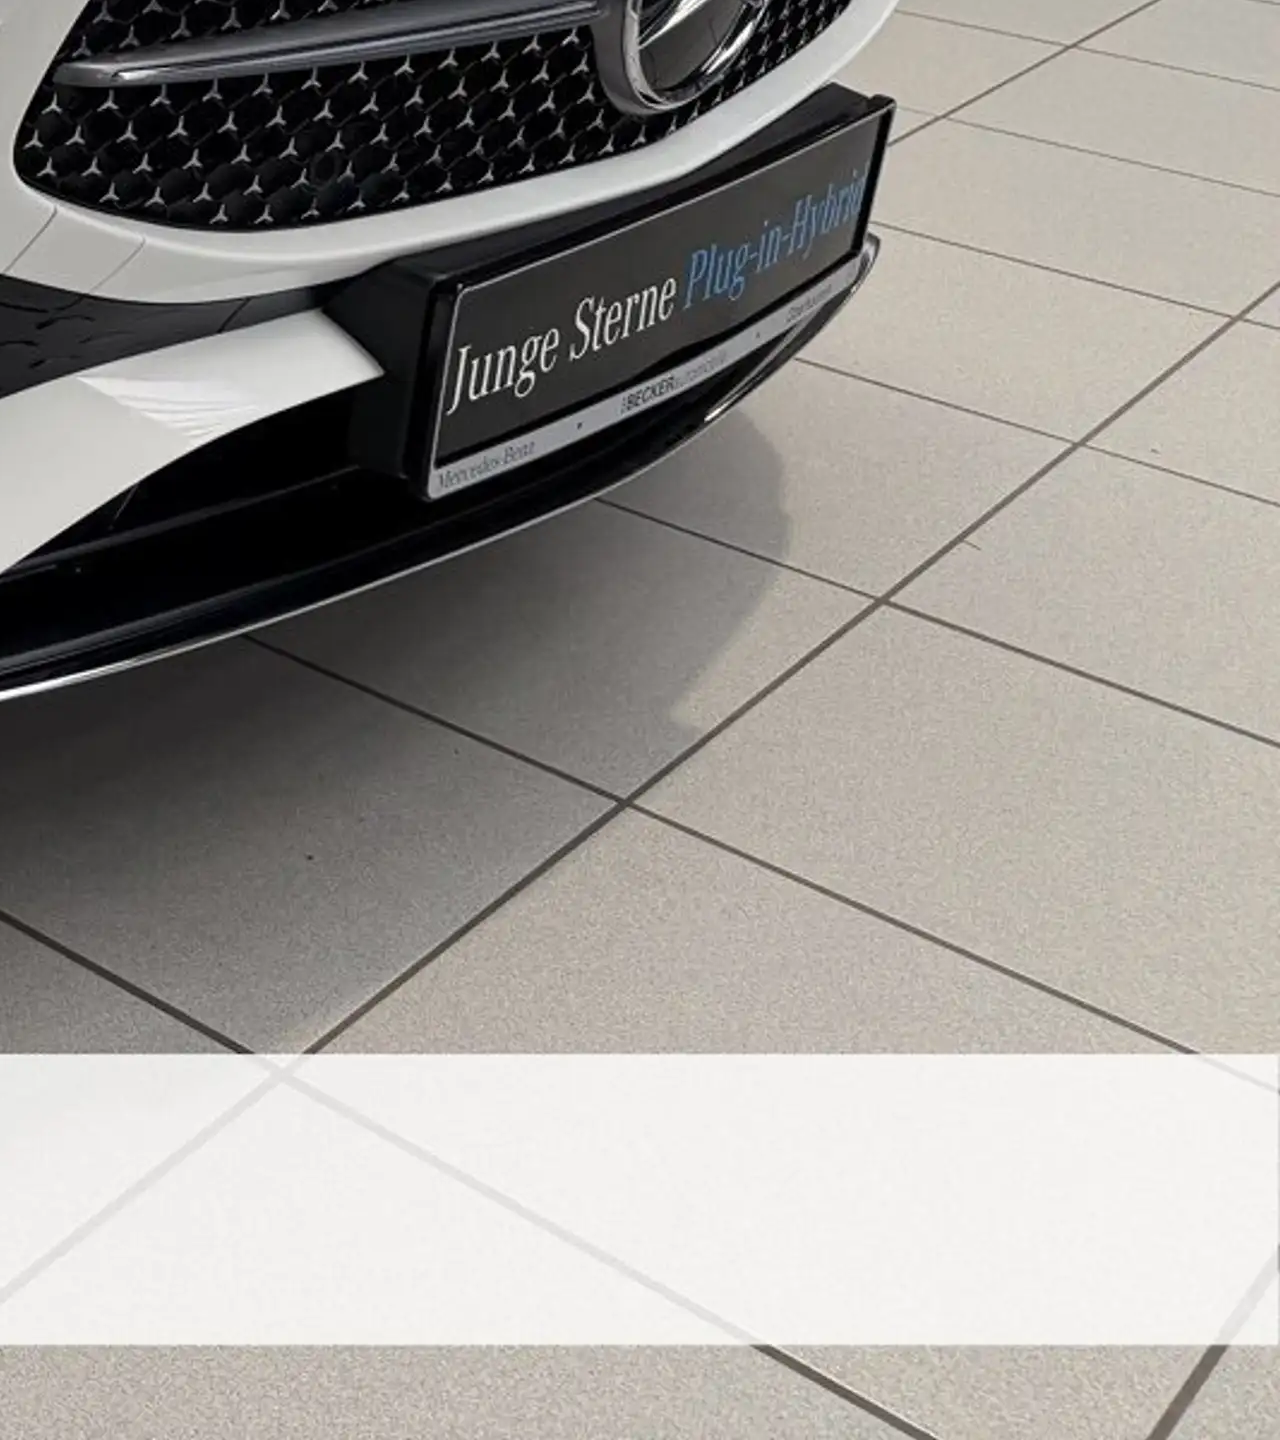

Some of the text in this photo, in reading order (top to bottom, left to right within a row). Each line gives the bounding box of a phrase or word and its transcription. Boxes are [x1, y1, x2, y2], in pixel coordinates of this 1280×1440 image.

[446, 327, 560, 416] Junge
[570, 277, 677, 361] Sterne
[683, 161, 870, 311] Plug-in-Hybrid
